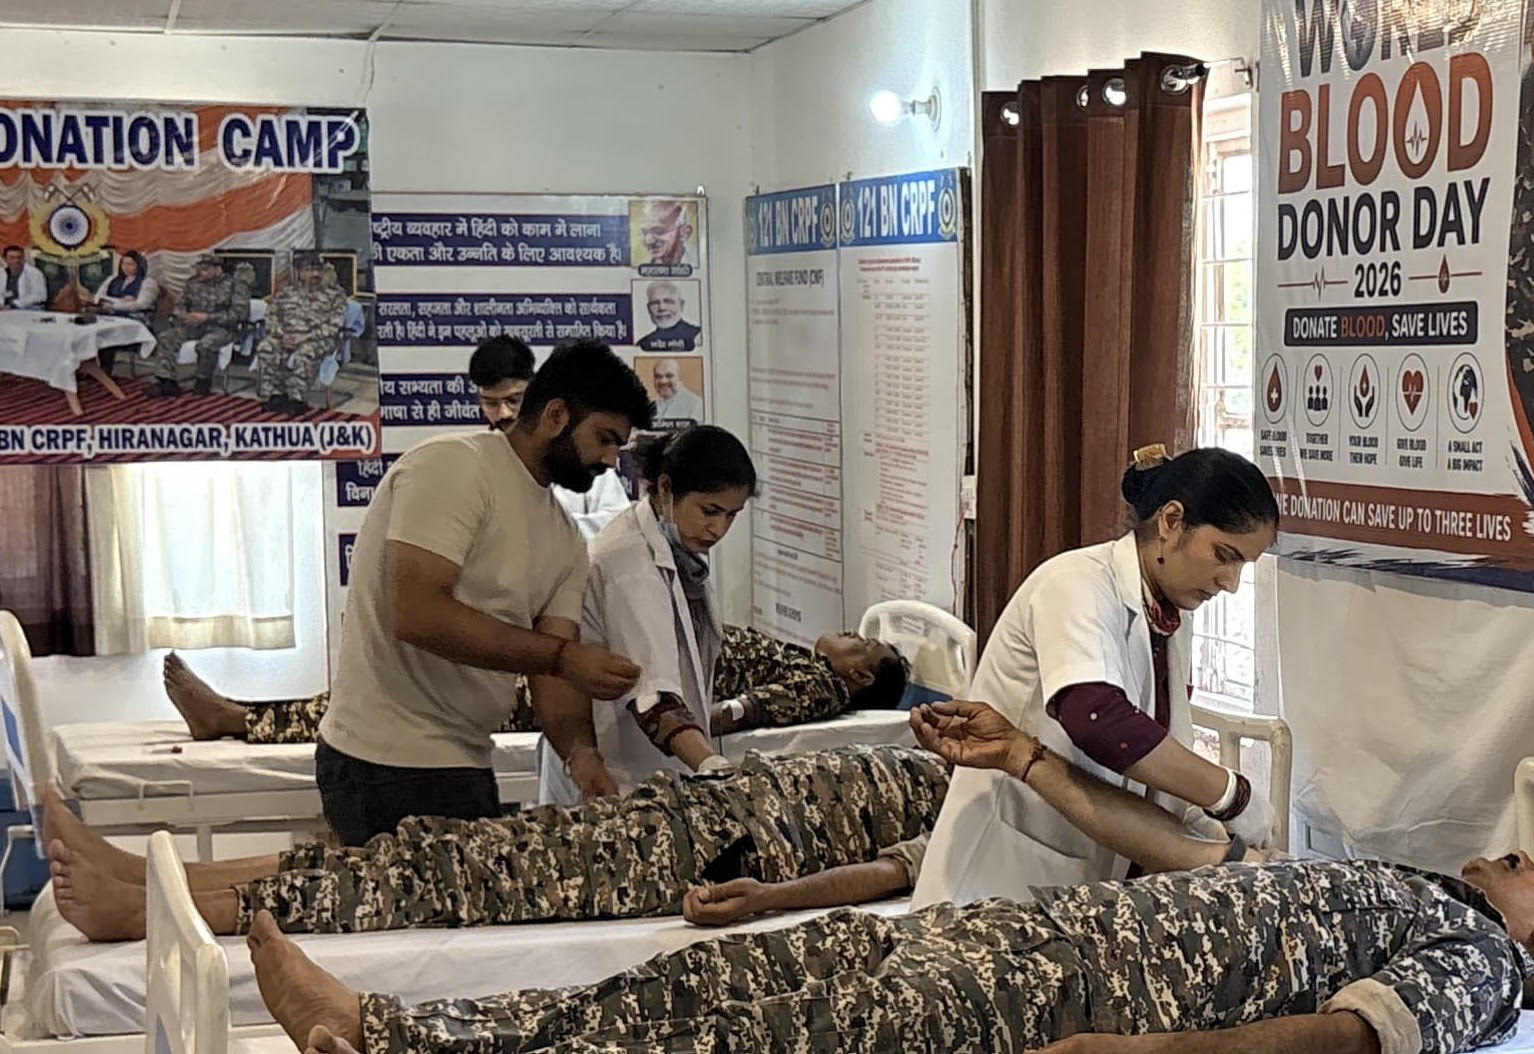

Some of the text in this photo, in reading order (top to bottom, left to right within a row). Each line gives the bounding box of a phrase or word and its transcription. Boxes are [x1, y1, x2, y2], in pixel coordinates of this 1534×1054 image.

[1278, 52, 1493, 194] BLOOD
[223, 117, 355, 169] CAMP
[758, 195, 818, 247] 121 BN CRPF
[857, 180, 936, 238] 121 BN CRPF
[1278, 177, 1491, 261] DONOR DAY
[406, 222, 453, 239] व्यवहार
[500, 217, 519, 237] को
[521, 223, 552, 237] काम
[569, 223, 602, 237] लाना
[385, 247, 425, 263] एकता
[428, 241, 455, 261] और
[501, 241, 516, 261] के
[518, 242, 545, 263] लिए
[549, 247, 607, 262] आवश्यक
[1354, 260, 1401, 298] 2026
[1293, 311, 1468, 341] DONATE BLOOD, SAVE LIVES
[398, 380, 444, 396] सभ्यता
[446, 376, 465, 395] की
[411, 400, 425, 420] से
[426, 400, 441, 421] ही
[0, 428, 25, 450] BN
[99, 425, 229, 452] HIRANAGAR,
[235, 425, 315, 448] KATHUA
[320, 424, 373, 451] (J&K)
[1453, 440, 1471, 454] SMALL
[1471, 441, 1483, 454] ACT
[1274, 492, 1512, 542] NE DONATION CAN SAVE UP TO THREE LIVES
